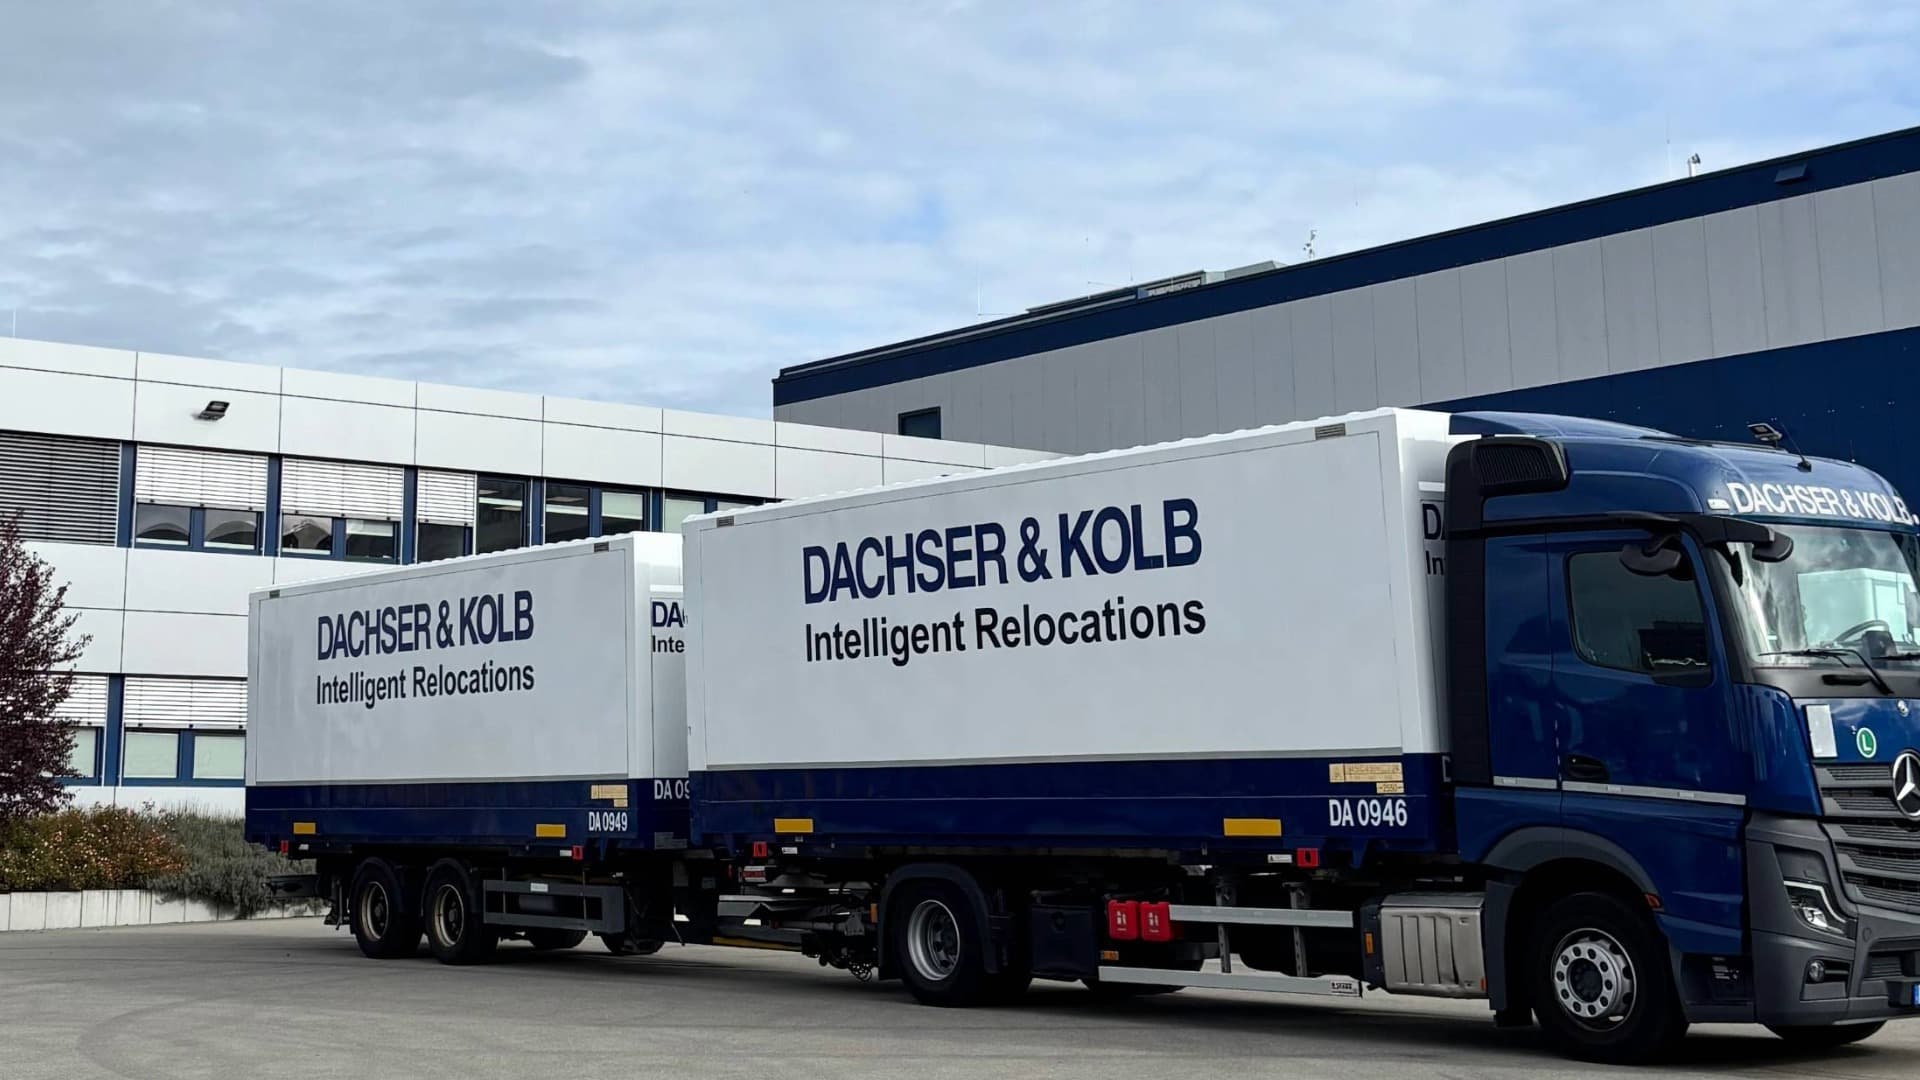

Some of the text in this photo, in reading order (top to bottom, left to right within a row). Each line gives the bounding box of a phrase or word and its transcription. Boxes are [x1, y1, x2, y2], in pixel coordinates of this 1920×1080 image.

[1727, 482, 1913, 525] DACHSER & KOLB
[802, 497, 1202, 604] DACHSER & KOLB
[317, 590, 535, 660] DACHSER & KOLB
[805, 595, 1206, 667] Intelligent Relocations
[316, 660, 535, 710] Intelligent Relocations
[654, 779, 673, 800] DA
[1328, 798, 1408, 827] DA 0946
[588, 811, 628, 832] DA 0949
